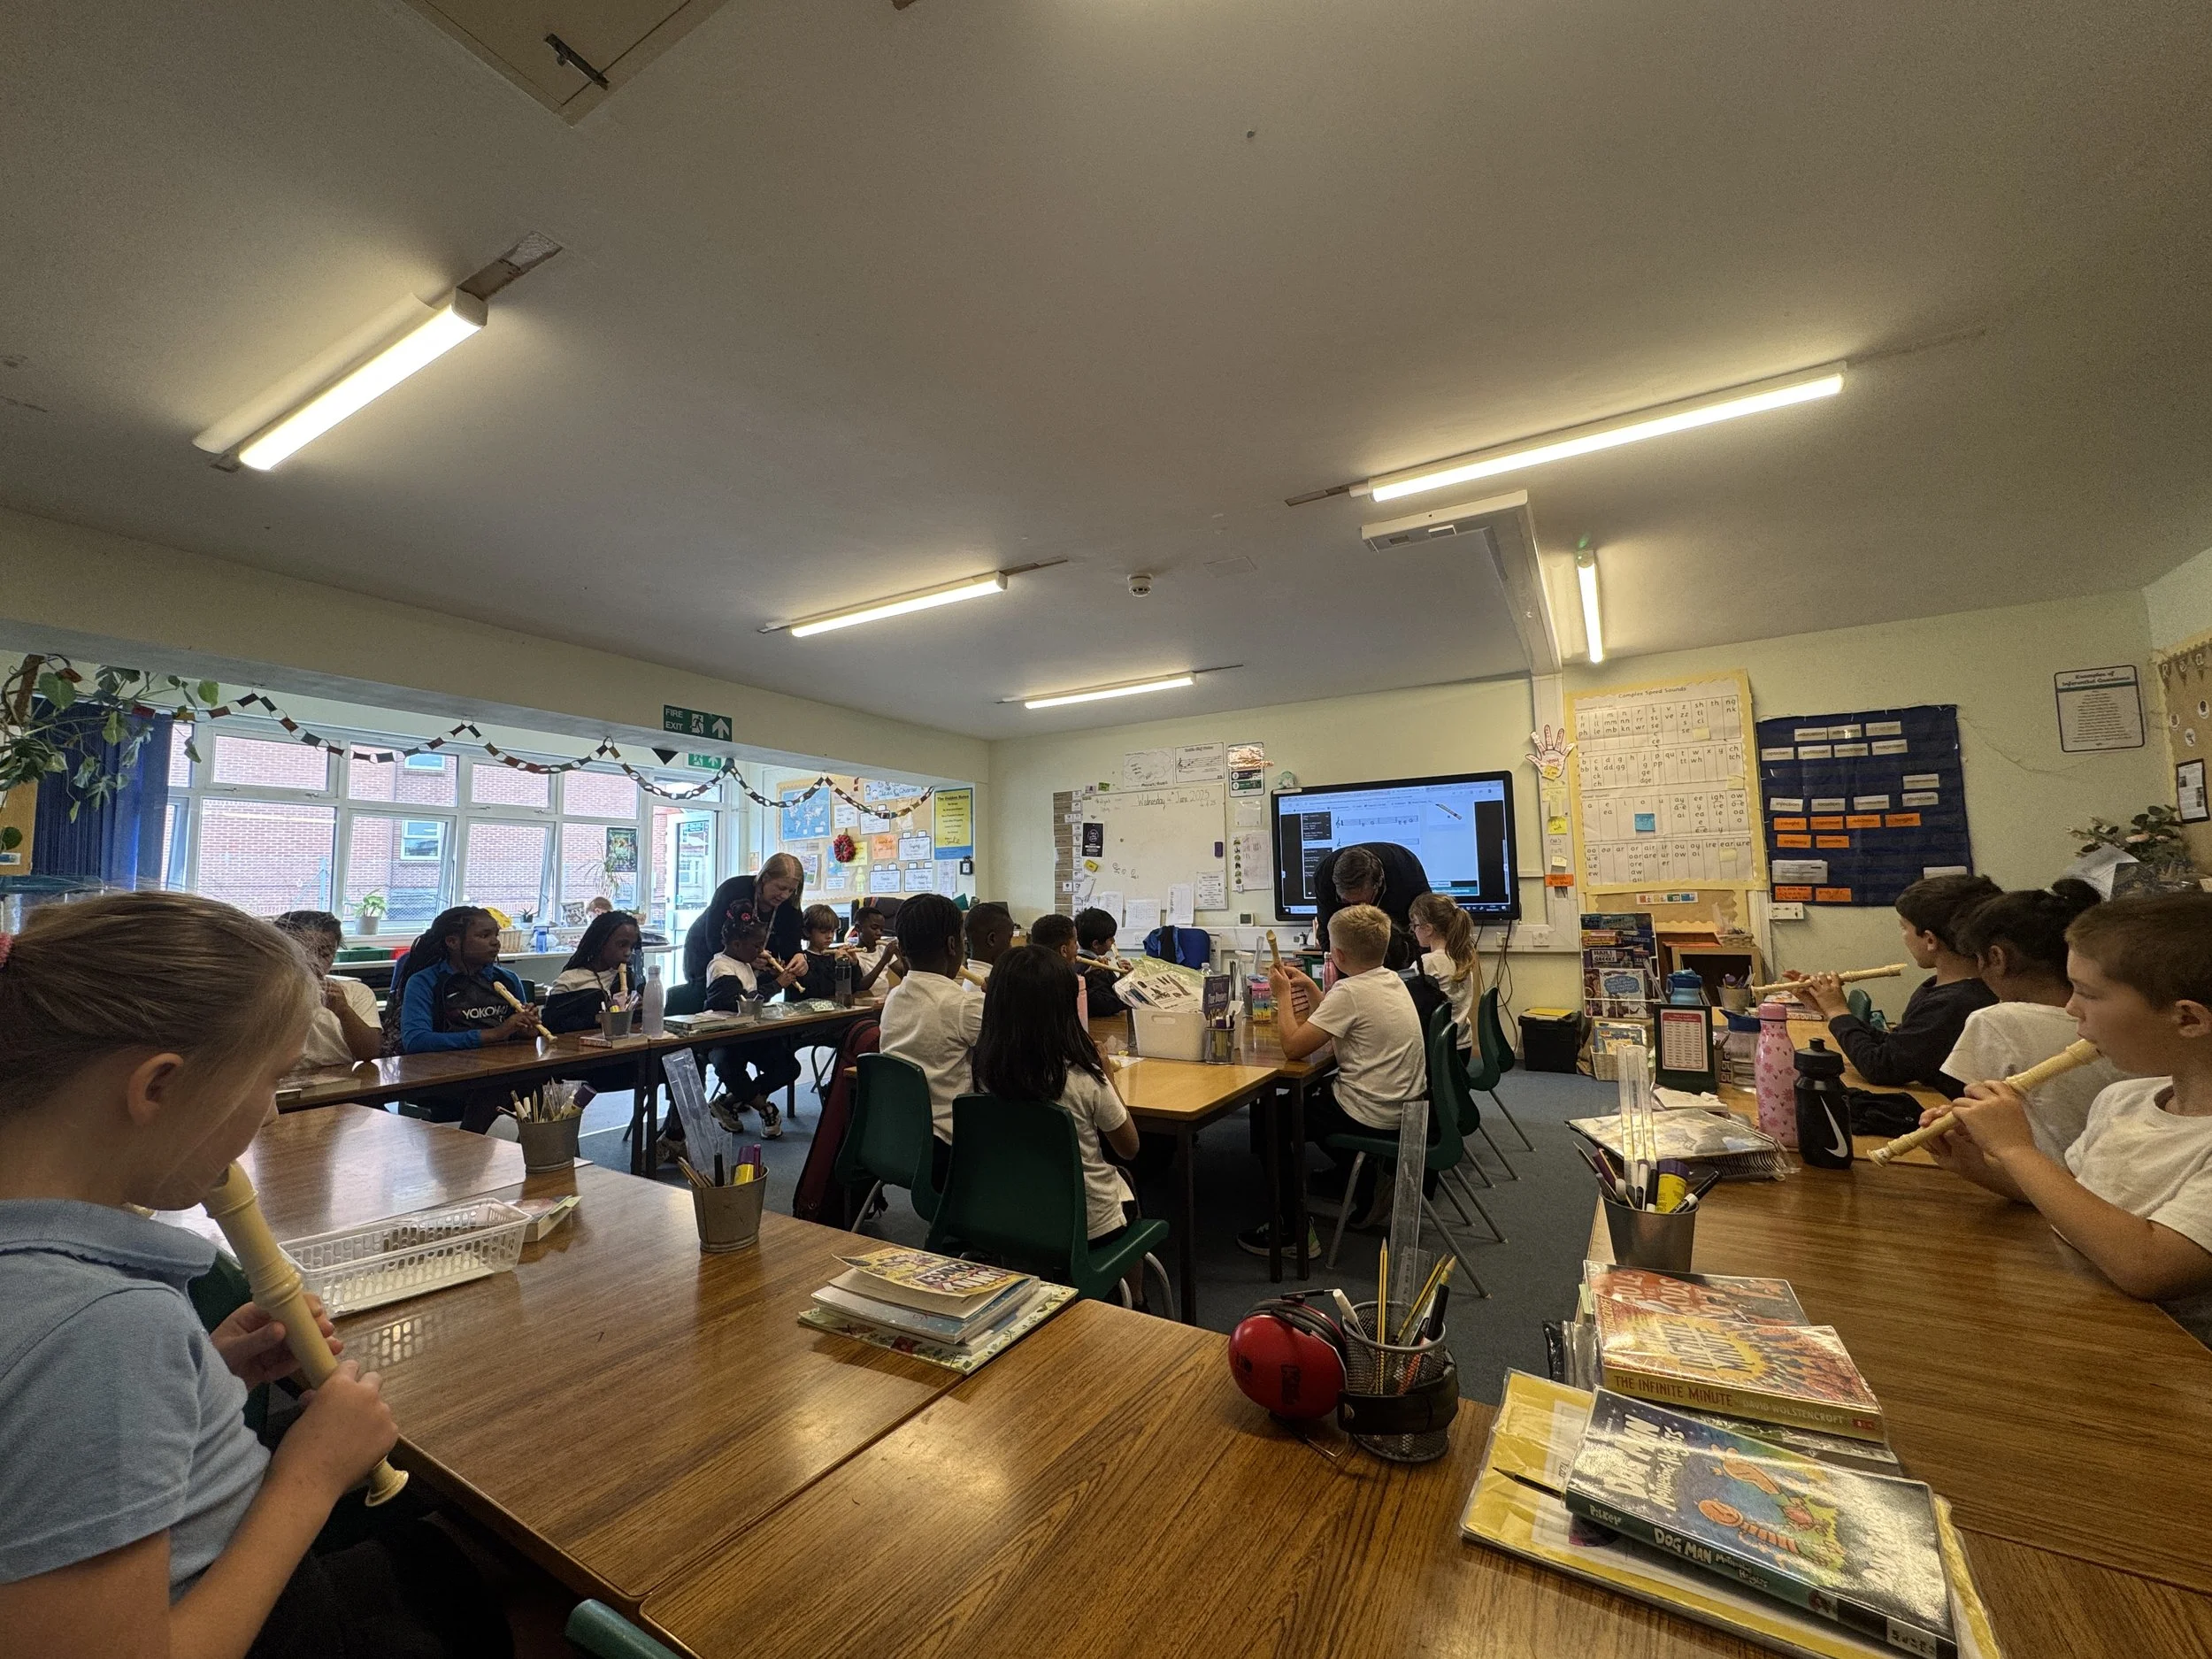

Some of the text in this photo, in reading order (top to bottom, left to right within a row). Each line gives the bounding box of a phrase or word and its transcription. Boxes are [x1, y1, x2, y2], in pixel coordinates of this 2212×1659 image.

[1645, 687, 1663, 696] Speed
[665, 708, 683, 718] FIRE
[665, 720, 683, 731] EXIT
[1137, 793, 1165, 810] Wednesday
[1175, 791, 1188, 803] June
[1189, 789, 1210, 803] 2025
[941, 1270, 1007, 1293] UNNY
[1659, 1279, 1701, 1317] GODS
[1659, 1318, 1716, 1371] INFINITE
[1696, 1327, 1755, 1373] MINUTE
[1614, 1375, 1634, 1390] THE
[1638, 1379, 1684, 1400] INFINITE
[1687, 1386, 1733, 1407] MINUTE
[1741, 1399, 1770, 1412] DAVID
[1771, 1404, 1845, 1425] WOLSTENCROFT
[1602, 1413, 1662, 1500] DOG MAN
[1654, 1527, 1682, 1555] DOG
[1684, 1541, 1713, 1565] MAN
